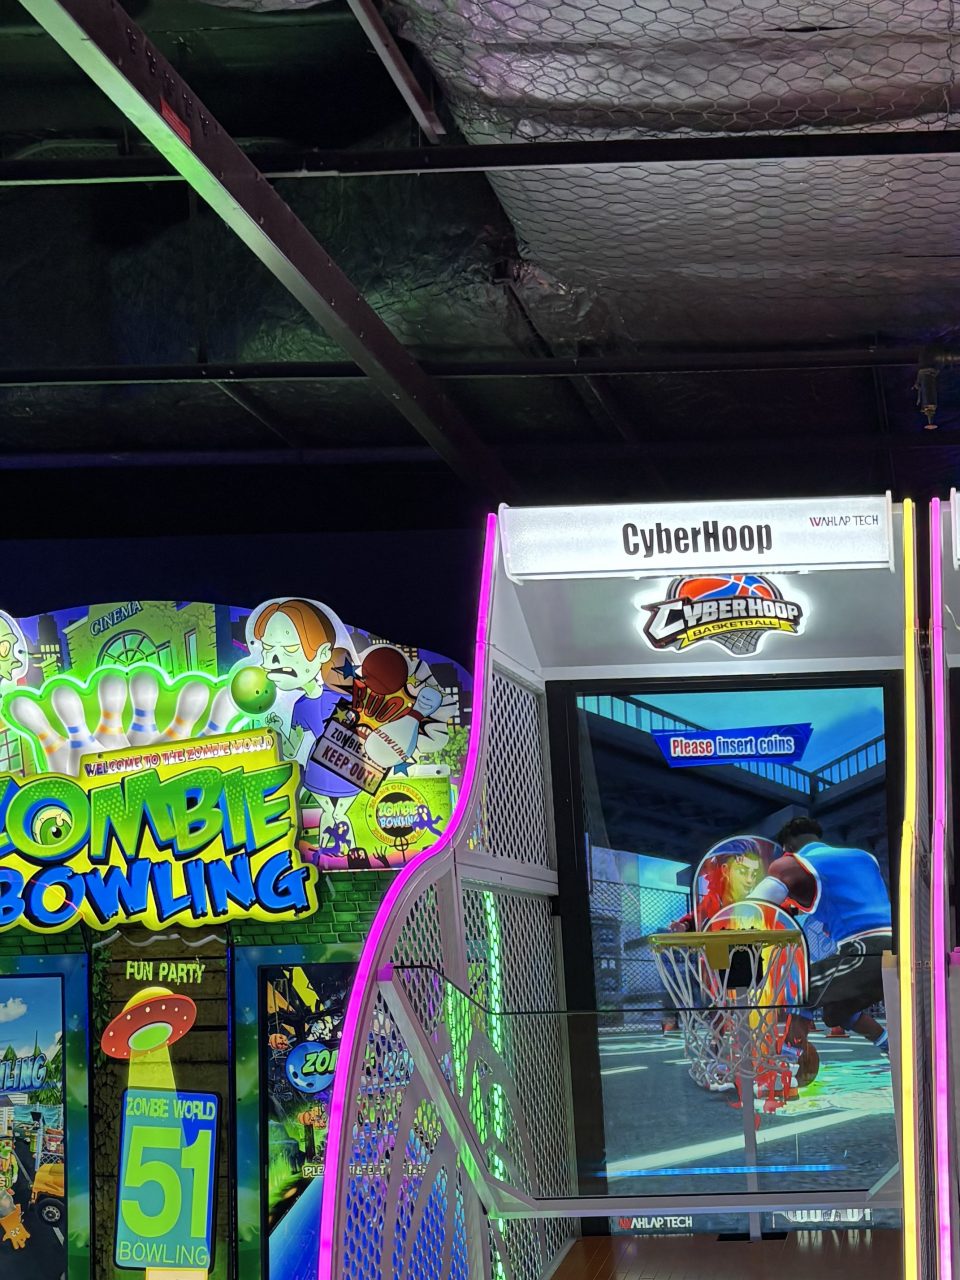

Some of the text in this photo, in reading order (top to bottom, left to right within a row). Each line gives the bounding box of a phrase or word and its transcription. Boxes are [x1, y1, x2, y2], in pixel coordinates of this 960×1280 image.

[809, 514, 879, 528] WAHLAP TECH
[622, 520, 773, 558] CyberHoop
[89, 601, 145, 636] CINEMA
[692, 618, 778, 638] BASKETBALL
[331, 727, 363, 754] ZOMBIE
[373, 729, 409, 762] BOWLING
[669, 733, 796, 757] Please insert coins
[85, 734, 275, 777] WELCOME TO THE ZOMBIE WORLD
[321, 745, 350, 770] KEEP
[350, 762, 377, 787] OUT!
[126, 958, 206, 984] FUN PARTY
[173, 1099, 216, 1121] WORLD
[121, 1125, 212, 1239] 51
[666, 1215, 693, 1229] TECH
[119, 1241, 209, 1266] BOWLING
